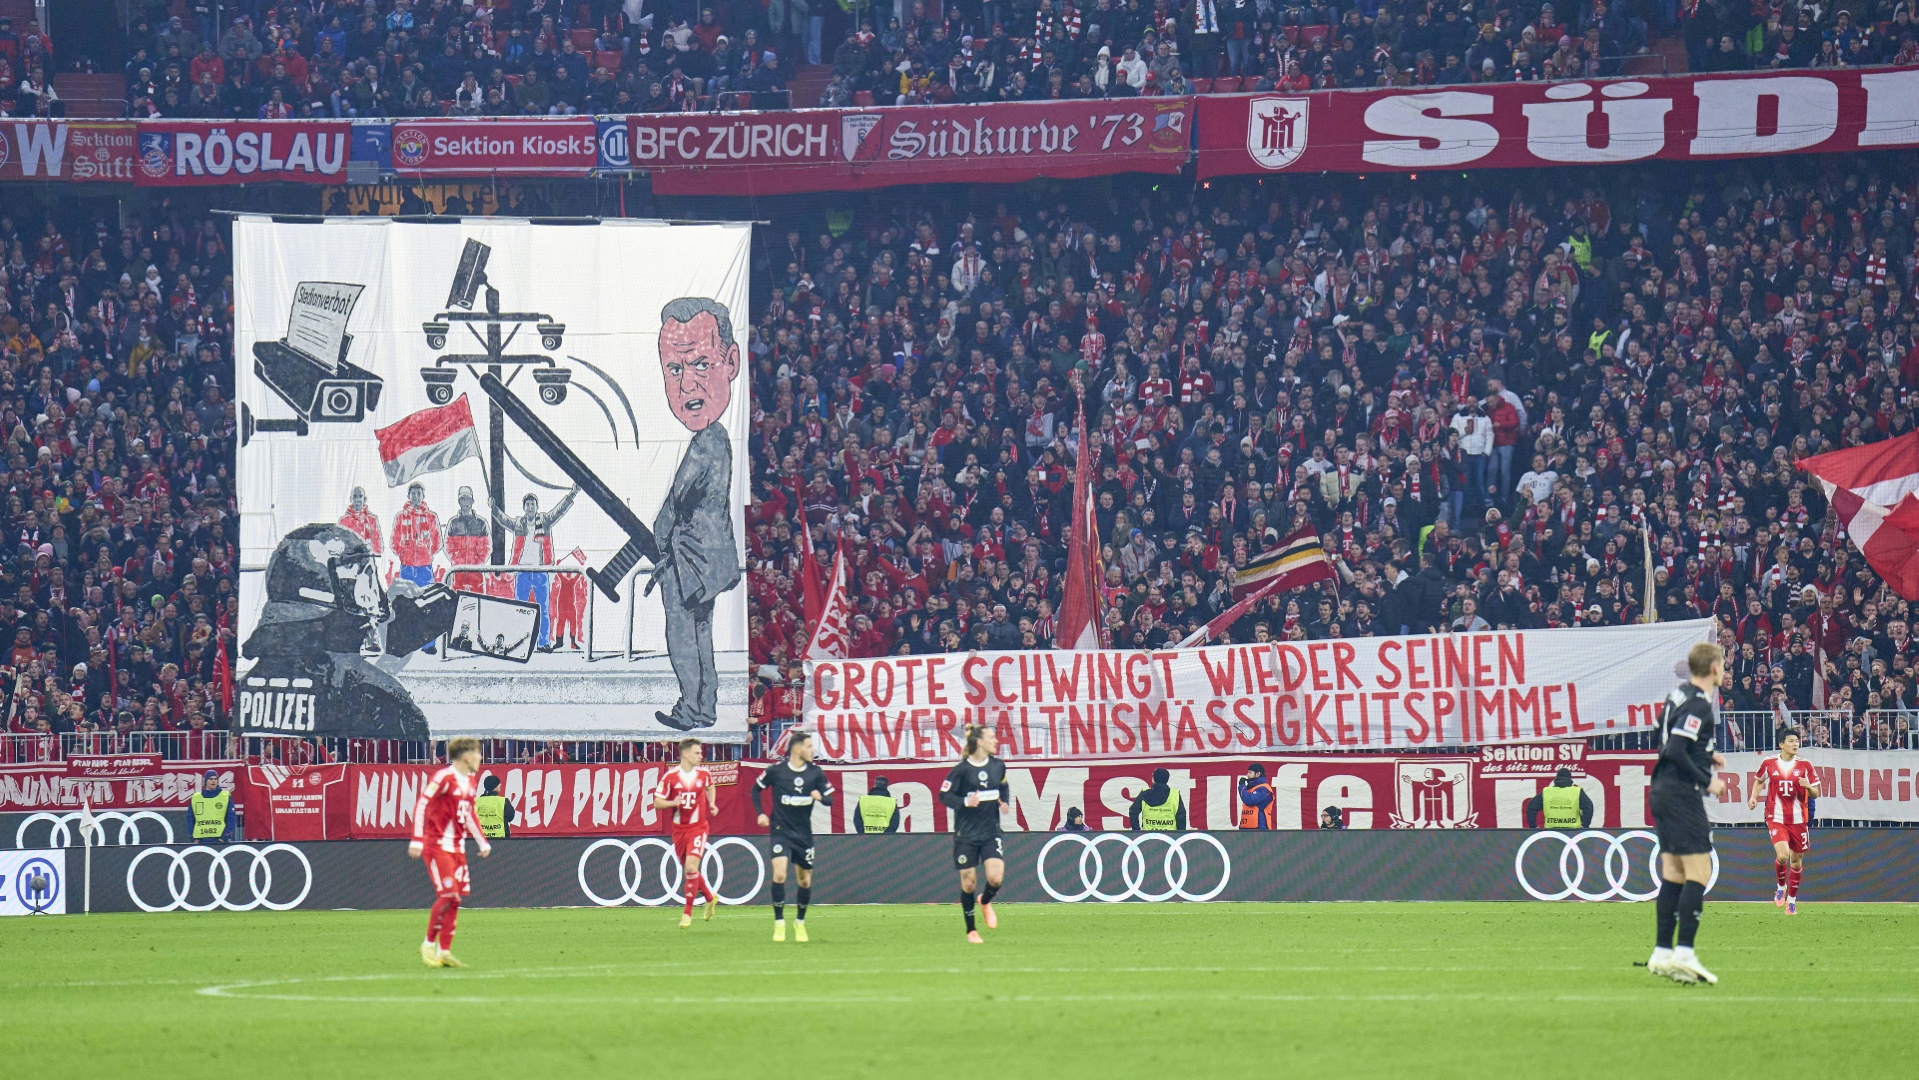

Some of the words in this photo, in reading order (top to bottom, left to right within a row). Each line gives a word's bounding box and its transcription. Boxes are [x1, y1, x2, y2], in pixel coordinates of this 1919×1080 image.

[71, 130, 133, 148] Sektion
[636, 125, 701, 160] BFC
[706, 121, 827, 160] ZÜRICH
[888, 114, 1079, 161] Südkurve
[1090, 111, 1144, 152] '73
[176, 129, 345, 176] RÖSLAU
[434, 136, 516, 156] Sektion
[72, 155, 134, 180] Suff
[297, 286, 352, 315] Stadionverbot
[519, 608, 531, 616] REC
[813, 657, 948, 711] GROTE
[962, 650, 1179, 706] SCHWINGT
[1199, 641, 1364, 697] WIEDER
[1376, 632, 1525, 692] SEINEN
[239, 691, 315, 731] POLIZEI
[1482, 744, 1555, 762] Sektion
[1559, 743, 1584, 761] SV
[1506, 761, 1529, 772] sitz
[1531, 763, 1553, 772] ma
[0, 773, 114, 807] MUNICH
[505, 769, 563, 828] RED
[573, 767, 659, 828] PRIDE
[1779, 780, 1793, 797] T
[681, 792, 697, 809] T
[481, 823, 502, 831] EWARD
[1145, 818, 1174, 826] STEWARD
[693, 835, 702, 848] 6
[454, 865, 471, 883] 42
